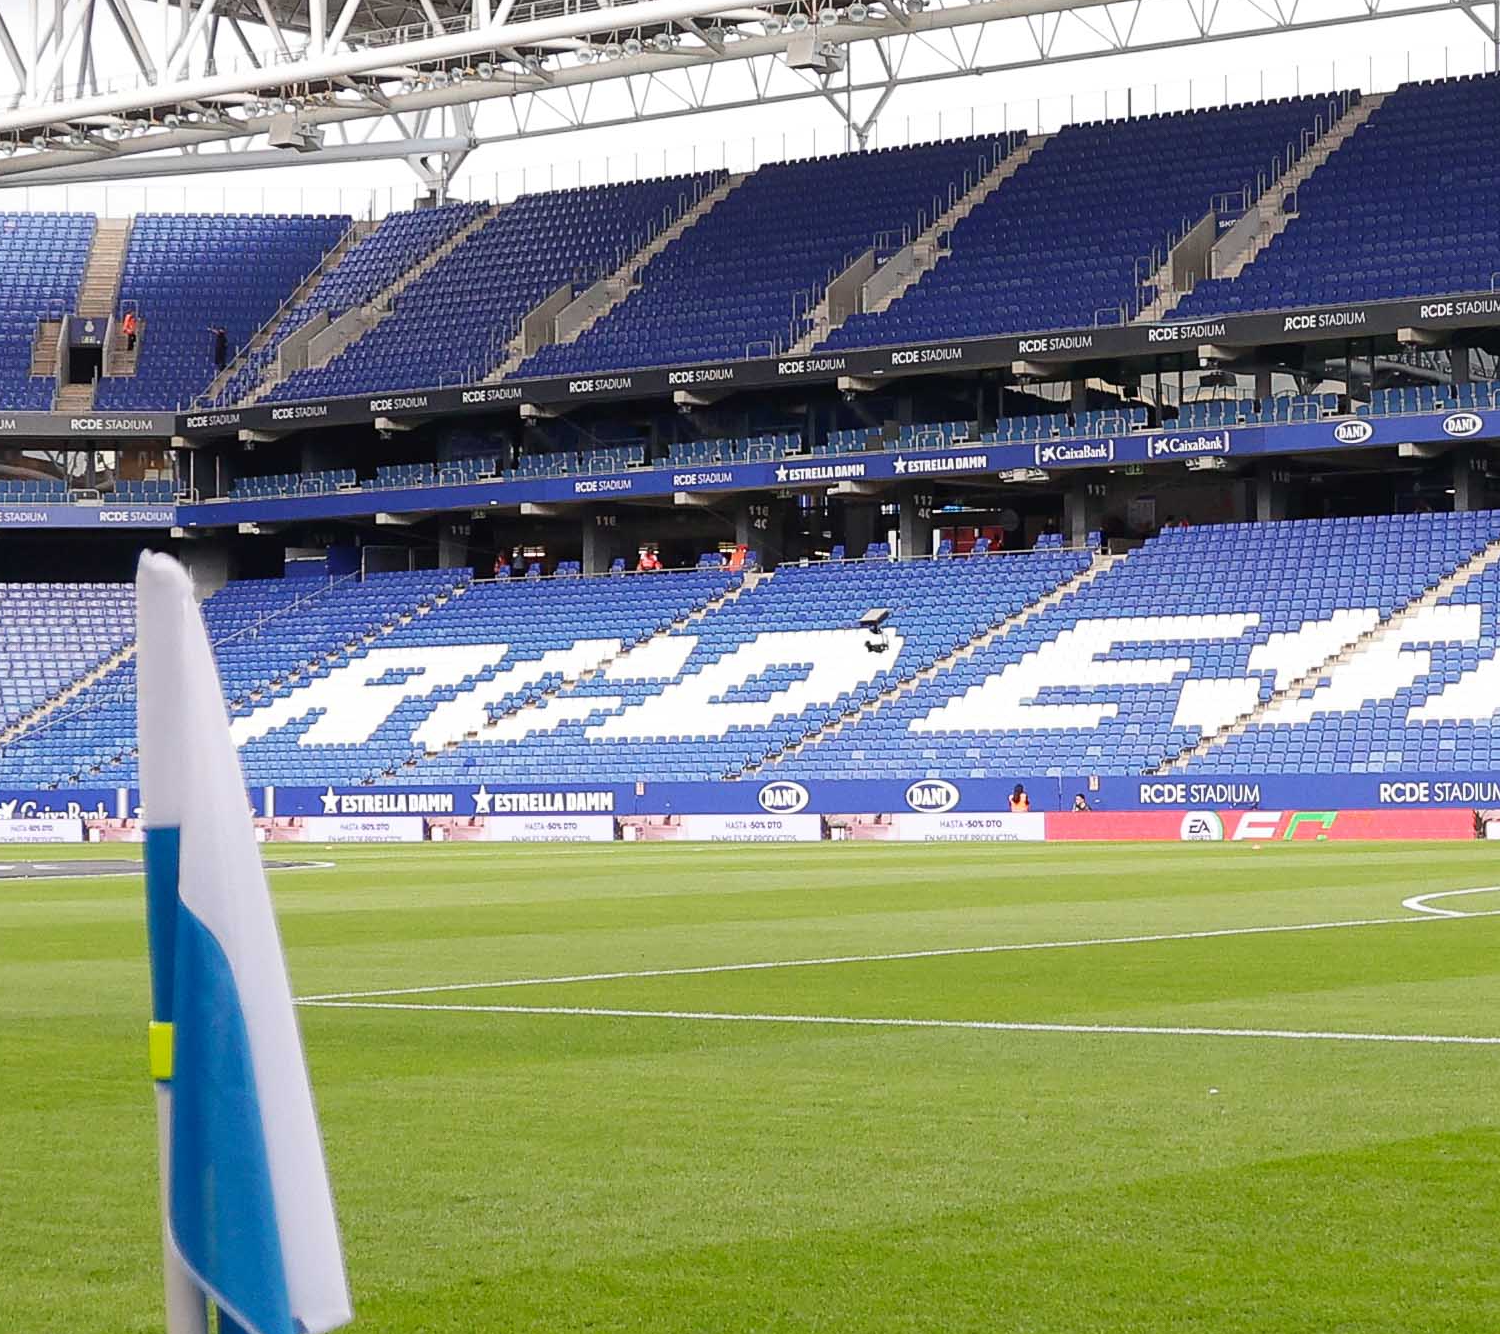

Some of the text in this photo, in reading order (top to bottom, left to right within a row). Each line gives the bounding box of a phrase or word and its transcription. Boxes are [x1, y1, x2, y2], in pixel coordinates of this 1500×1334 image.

[1283, 311, 1366, 332] RCDE STADIUM
[1019, 335, 1093, 354] RCDE STADIUM
[1338, 423, 1364, 439] DANI
[1448, 418, 1473, 432] DANI
[1056, 443, 1108, 460] CaixaBank
[1169, 435, 1223, 453] CaixaBank
[789, 464, 865, 481] ESTRELLA DAMM
[907, 455, 987, 473] ESTRELLA DAMM
[575, 479, 632, 493] RCDE STADIUM
[765, 789, 797, 806] DANI
[911, 787, 946, 808] DANI
[1140, 783, 1260, 804] RCDE STADIUM
[1379, 782, 1430, 803] RCDE
[341, 794, 453, 813] ESTRELLA DAMM
[495, 792, 613, 812] ESTRELLA DAMM
[1188, 819, 1211, 834] EA
